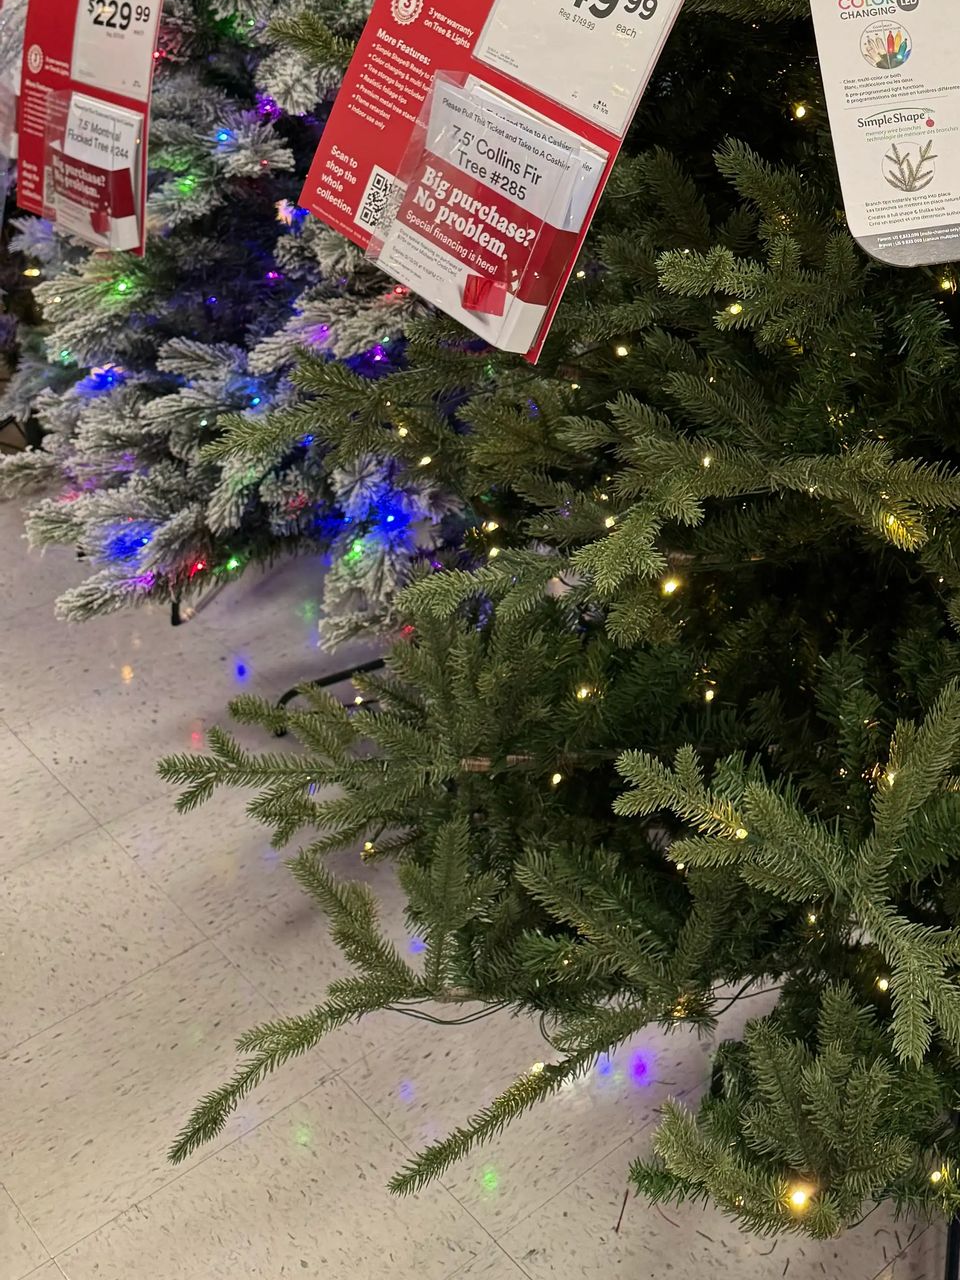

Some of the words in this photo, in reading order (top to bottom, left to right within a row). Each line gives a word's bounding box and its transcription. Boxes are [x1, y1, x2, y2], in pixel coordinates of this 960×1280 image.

[135, 5, 150, 23] 99
[433, 11, 448, 22] year
[448, 17, 474, 37] warranty
[559, 8, 570, 21] Reg.
[840, 6, 896, 20] CHANGING
[424, 19, 432, 28] on
[432, 21, 446, 35] Tree
[452, 32, 470, 48] Lights
[616, 23, 637, 38] each
[375, 44, 392, 58] Simple
[410, 63, 426, 77] Ready
[376, 28, 396, 46] More
[396, 38, 431, 65] Features:
[371, 54, 385, 64] Color
[384, 62, 405, 79] changing
[363, 74, 382, 90] Realistic
[381, 84, 400, 99] foliage
[398, 94, 407, 104] tips
[368, 64, 377, 74] Tree
[377, 69, 396, 86] storage
[395, 80, 405, 90] bag
[404, 84, 425, 101] included
[355, 94, 371, 108] Flame
[369, 103, 390, 119] retardant
[359, 84, 380, 100] Premium
[379, 96, 393, 108] metal
[392, 103, 402, 113] tree
[402, 109, 416, 122] stand
[351, 105, 367, 118] Indoor
[374, 119, 385, 130] only
[443, 97, 462, 113] Please
[461, 107, 474, 119] Pull
[474, 114, 487, 127] This
[487, 120, 506, 136] Ticket
[505, 131, 516, 143] and
[518, 137, 532, 152] Take
[532, 146, 540, 154] to
[331, 145, 348, 163] Scan
[349, 158, 358, 168] to
[452, 125, 475, 146] 7.5'
[476, 138, 521, 174] Collins
[523, 164, 542, 185] Fir
[322, 173, 343, 192] whole
[326, 160, 344, 176] shop
[344, 170, 357, 184] the
[457, 149, 487, 179] Tree
[490, 171, 527, 200] #285
[316, 187, 352, 215] collection.
[421, 165, 450, 199] Big
[448, 187, 536, 247] purchase?
[413, 186, 436, 212] No
[435, 205, 508, 260] problem.
[406, 210, 435, 234] Special
[434, 226, 470, 258] financing
[469, 250, 476, 261] is
[476, 255, 498, 275] here!
